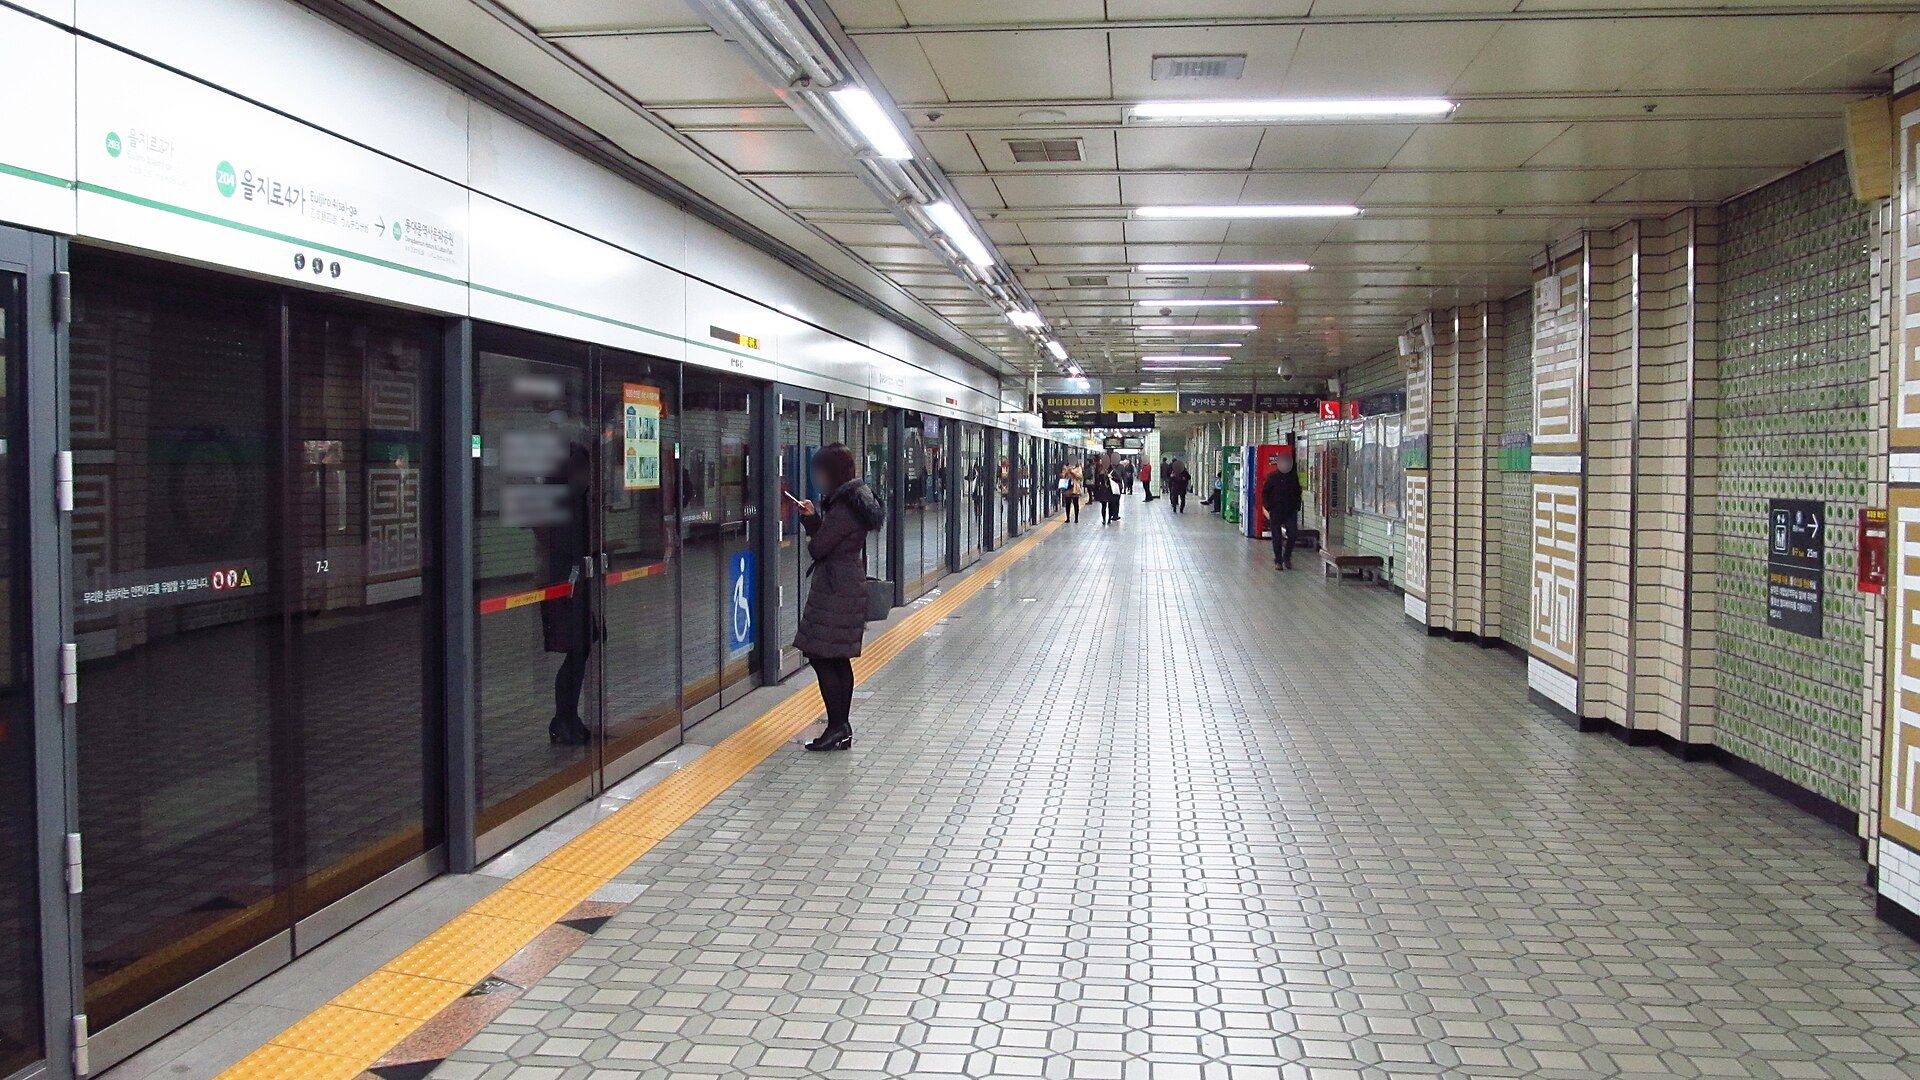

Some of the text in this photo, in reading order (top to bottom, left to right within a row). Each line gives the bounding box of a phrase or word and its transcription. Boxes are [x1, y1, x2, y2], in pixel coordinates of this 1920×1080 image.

[218, 170, 234, 187] 204
[240, 169, 306, 215] 을지로4가
[1118, 398, 1139, 406] 나가는
[316, 560, 329, 573] 7-2
[83, 590, 104, 603] 무리한
[179, 581, 185, 590] 수
